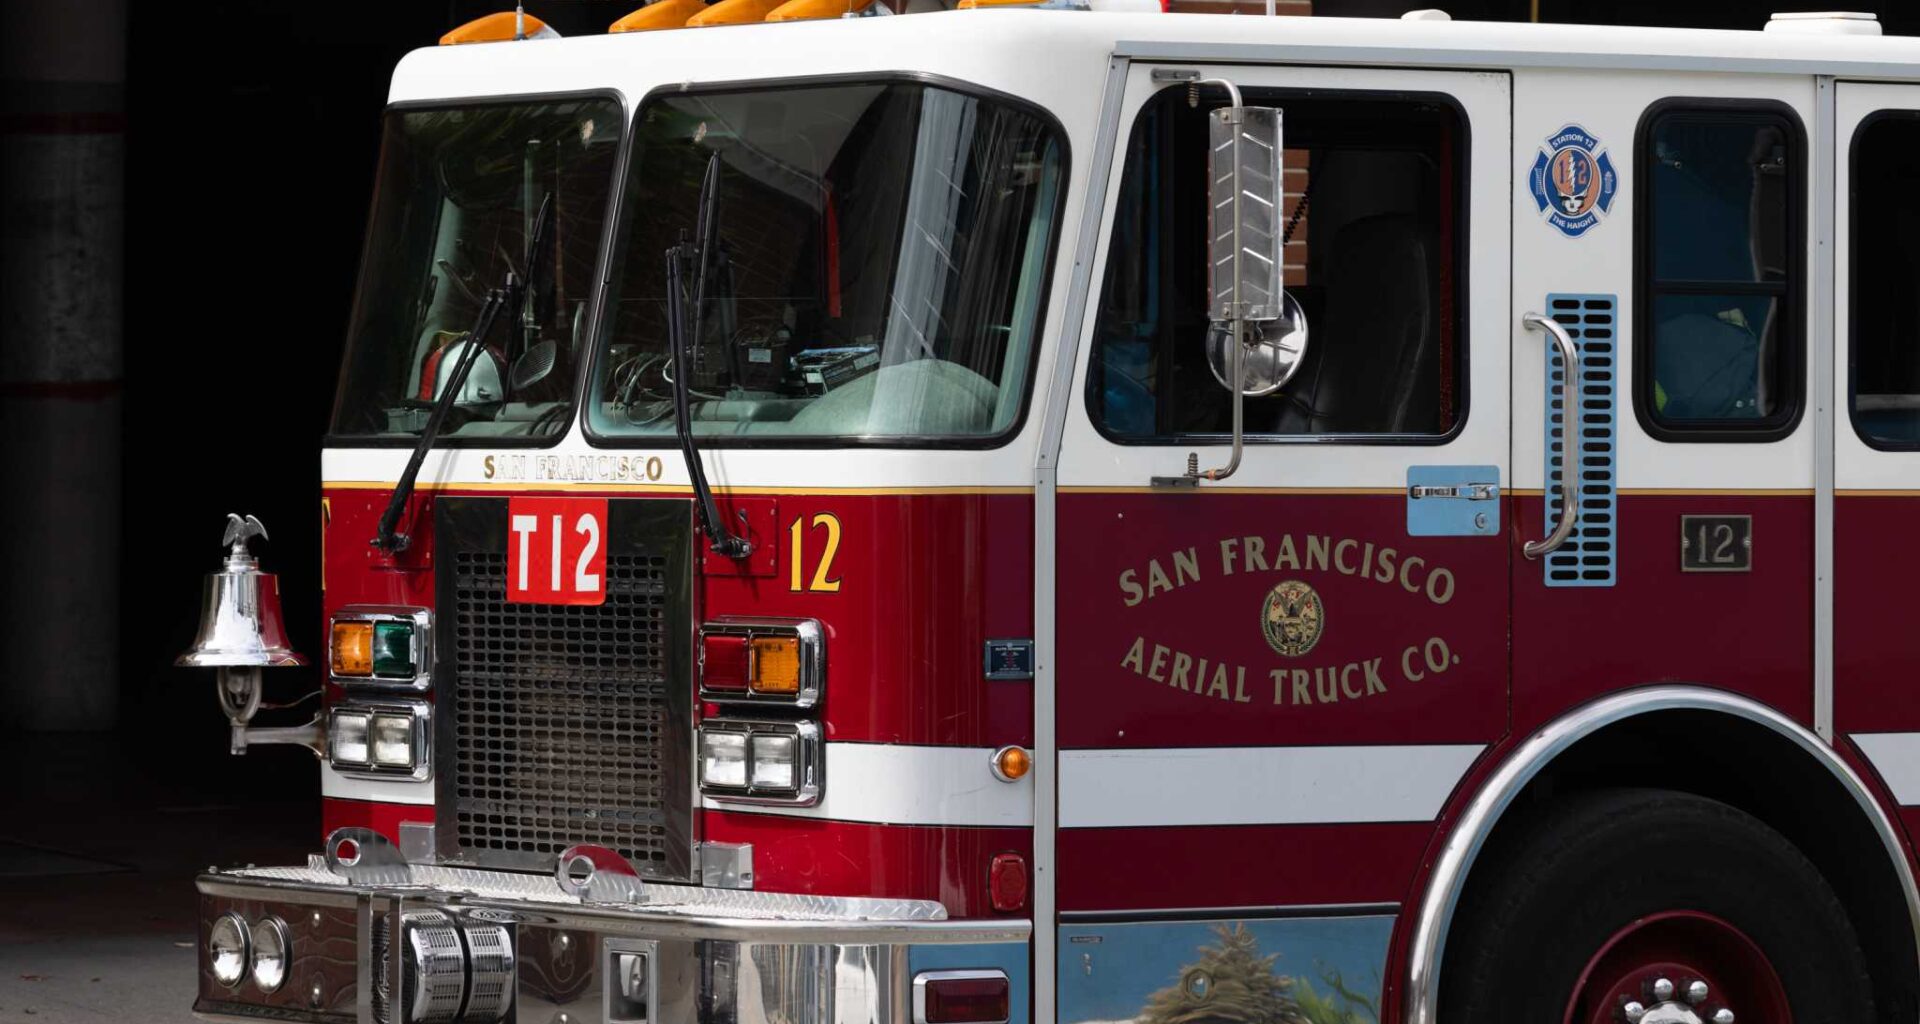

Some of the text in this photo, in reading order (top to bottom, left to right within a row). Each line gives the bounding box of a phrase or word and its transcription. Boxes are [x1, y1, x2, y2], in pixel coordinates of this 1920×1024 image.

[1552, 133, 1594, 148] STATION 12
[1553, 214, 1594, 229] THE HAIGHT
[484, 455, 663, 481] SAN FRANCISCO
[512, 513, 600, 592] T12
[788, 511, 842, 593] 12
[1119, 534, 1455, 607] SAN FRANCISCO
[1698, 523, 1735, 563] 12
[1121, 635, 1460, 705] AERIAL TRUCK CO.
